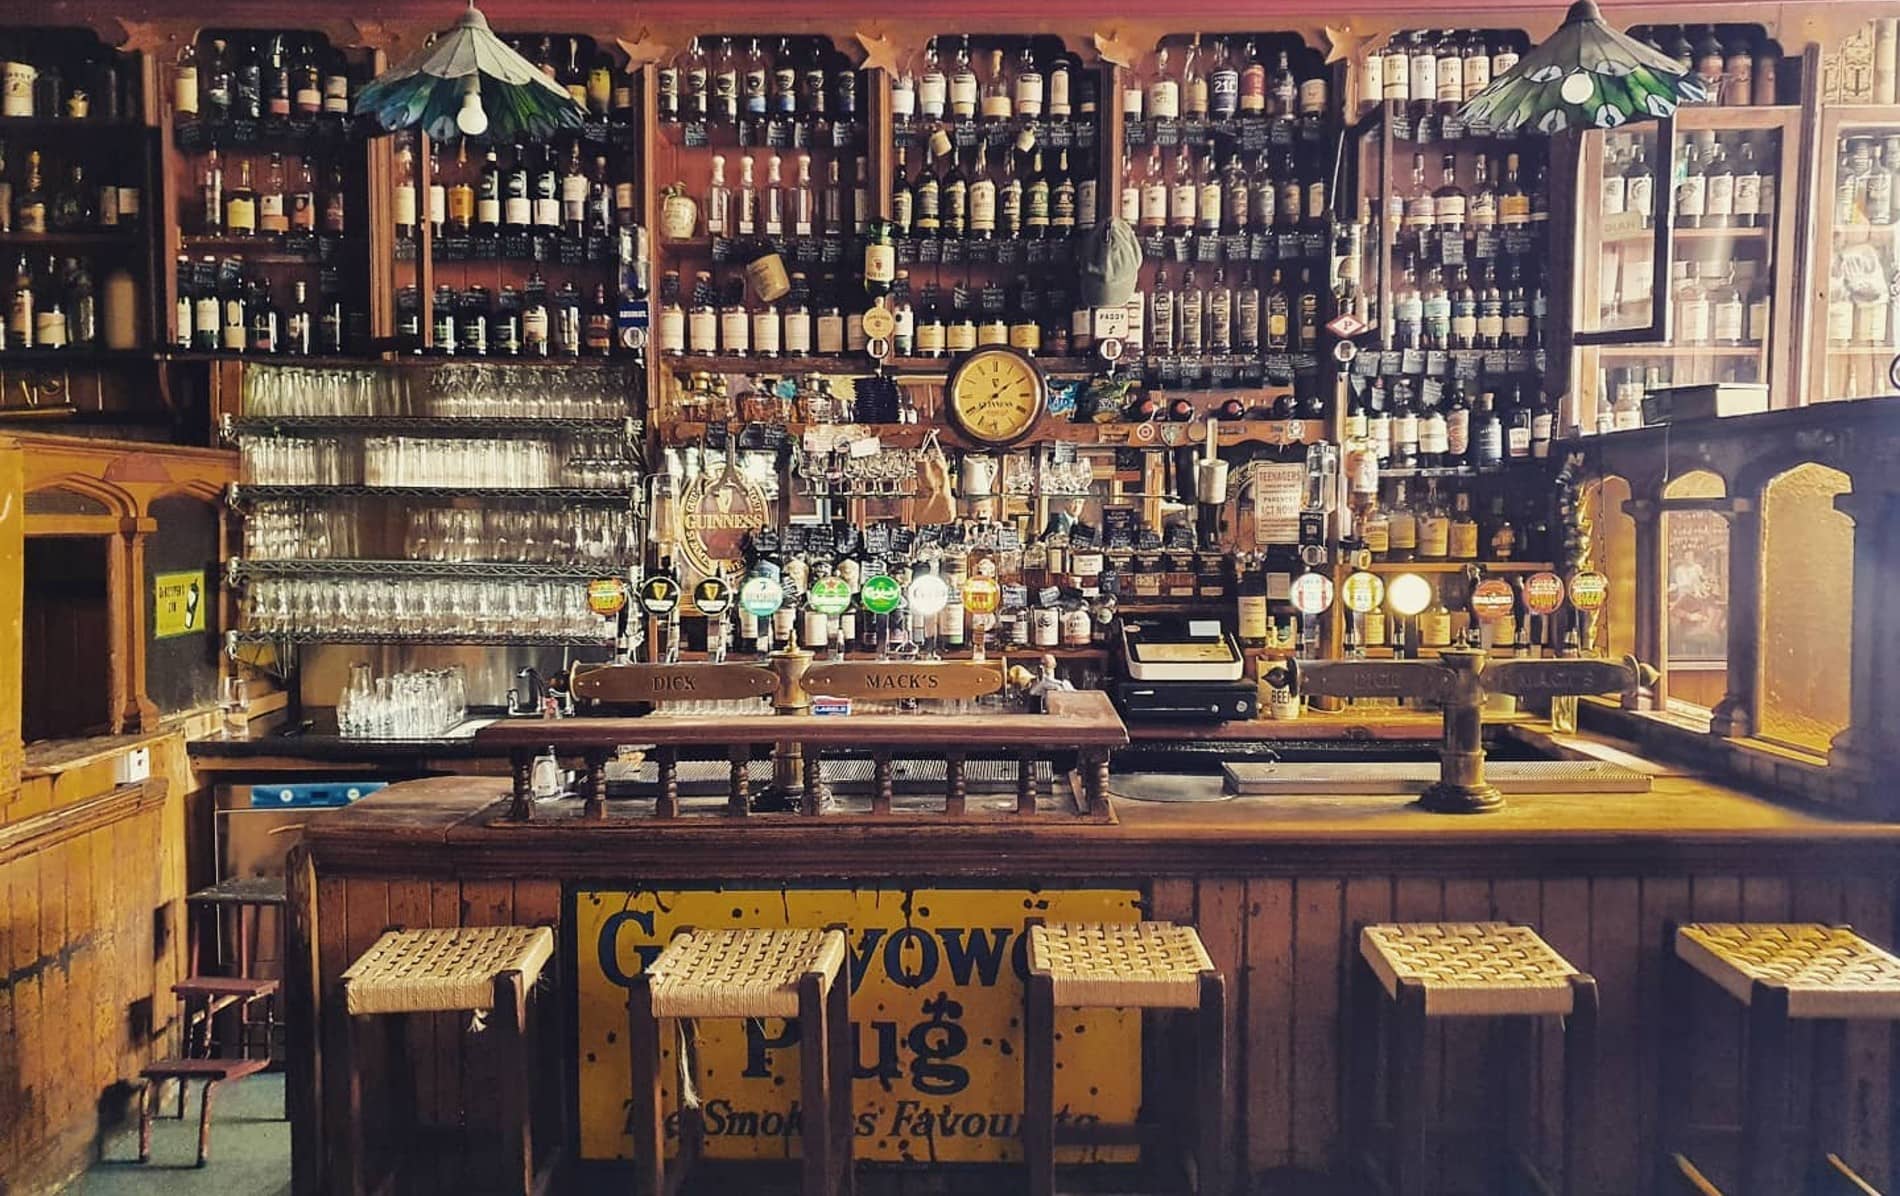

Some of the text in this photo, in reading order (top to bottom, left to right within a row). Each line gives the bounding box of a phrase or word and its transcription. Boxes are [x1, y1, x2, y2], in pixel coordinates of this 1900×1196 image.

[684, 513, 763, 530] GUINNESS
[652, 676, 696, 690] DICK
[865, 674, 939, 689] MACK'S
[742, 1000, 970, 1096] Pug
